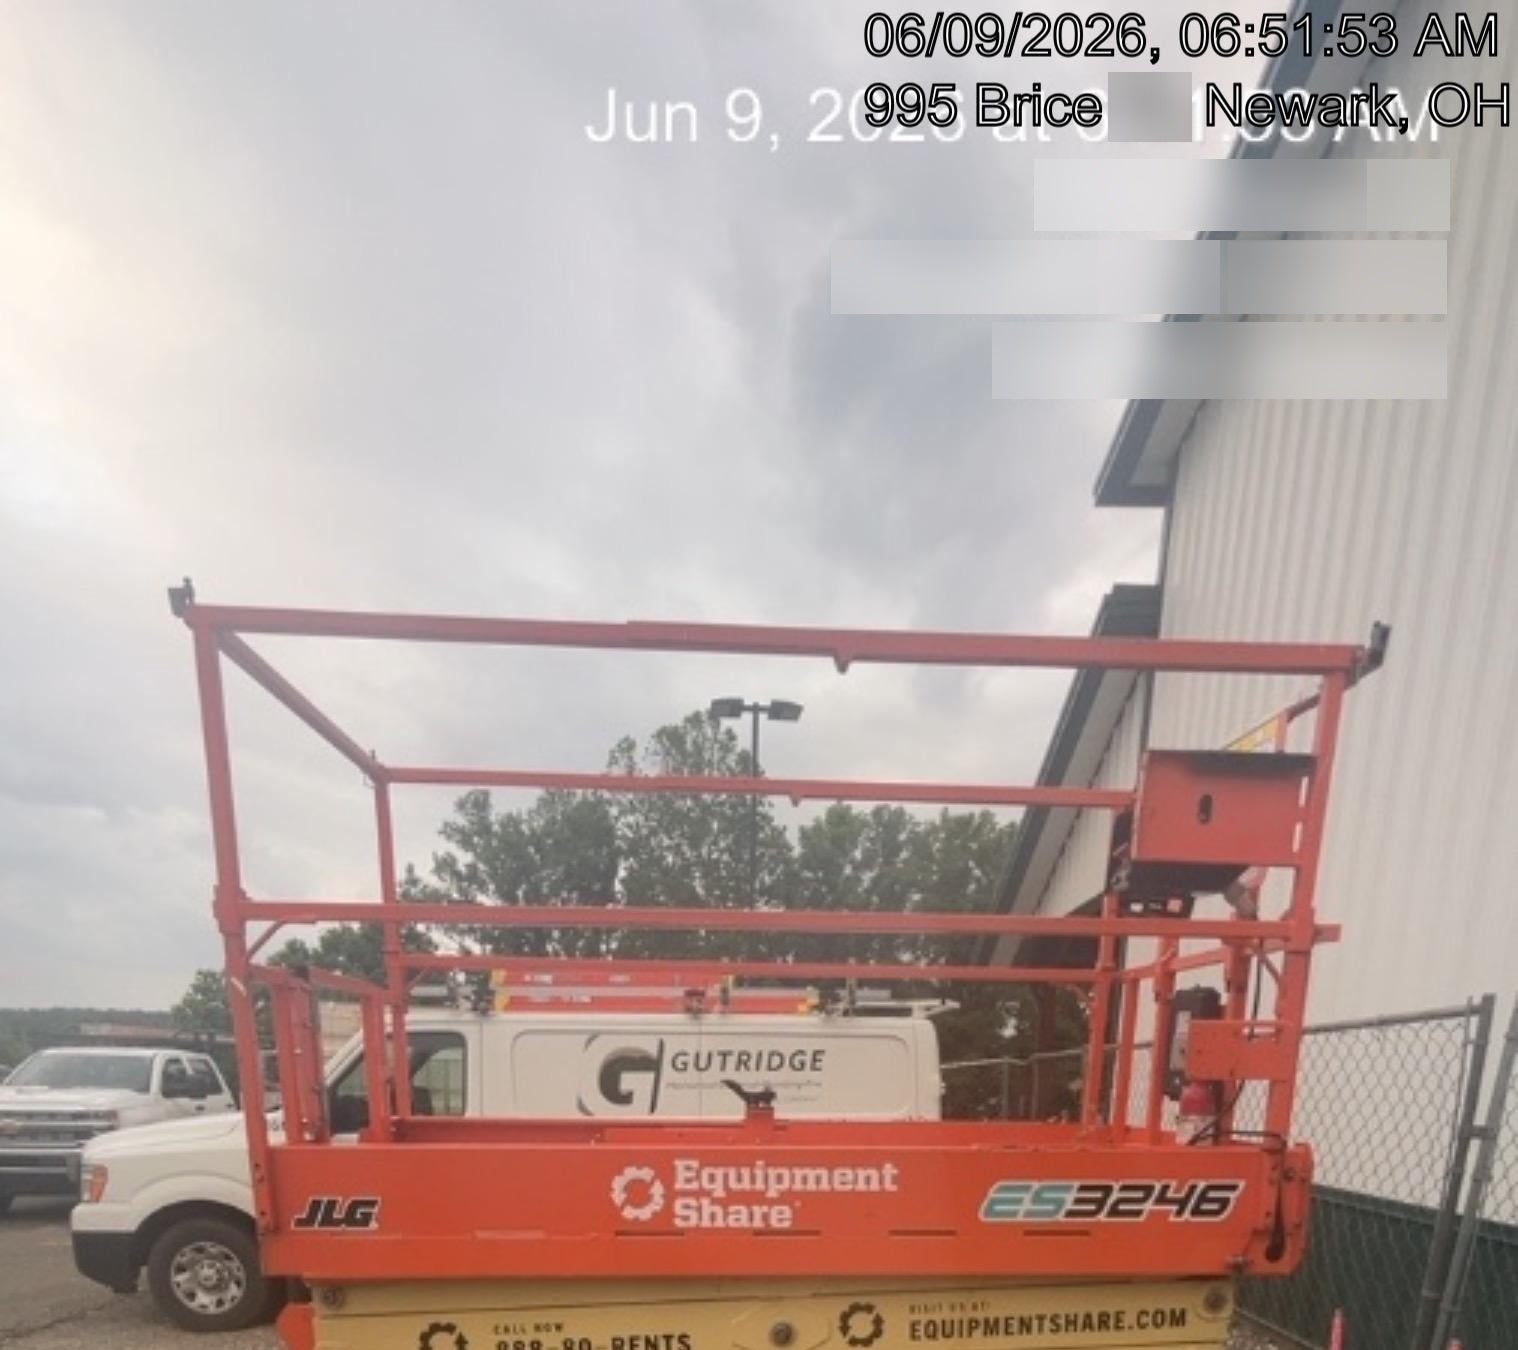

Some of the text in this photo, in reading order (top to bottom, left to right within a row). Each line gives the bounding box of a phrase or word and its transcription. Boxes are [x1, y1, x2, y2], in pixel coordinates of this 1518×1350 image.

[671, 1049, 826, 1073] GUTRIDGE
[673, 1159, 899, 1198] Equipment
[291, 1197, 381, 1230] JLG
[673, 1197, 793, 1228] Share
[978, 1180, 1246, 1222] ES3246
[909, 1307, 1188, 1342] EQUIPMENTSHARE.COM
